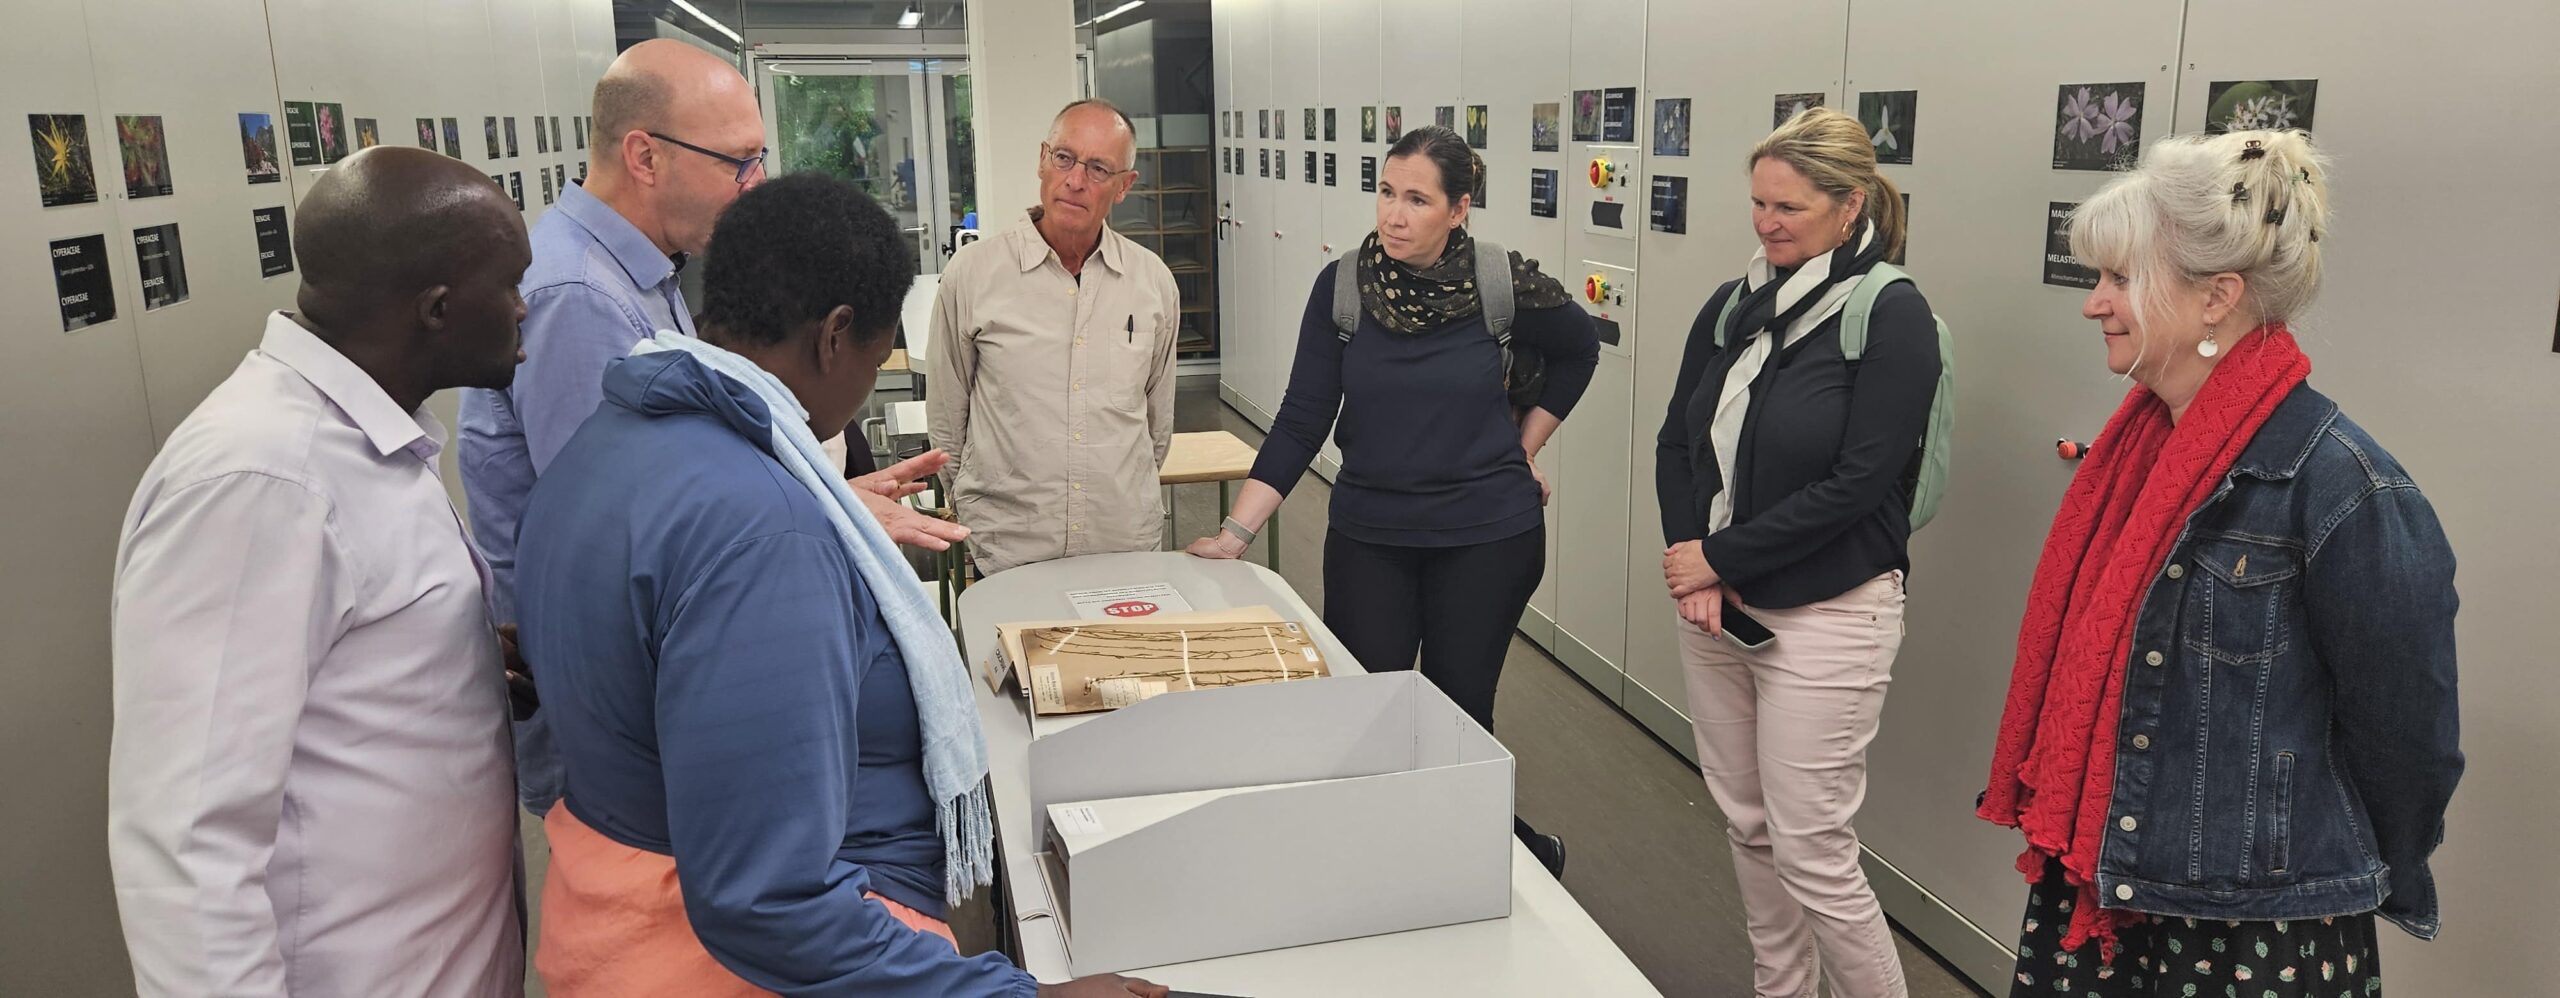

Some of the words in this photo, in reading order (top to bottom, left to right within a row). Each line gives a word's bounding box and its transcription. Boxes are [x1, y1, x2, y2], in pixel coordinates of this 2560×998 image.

[52, 245, 81, 258] CYPERACEAE
[61, 292, 89, 306] CYPERACEAE
[1106, 603, 1154, 615] STOP
